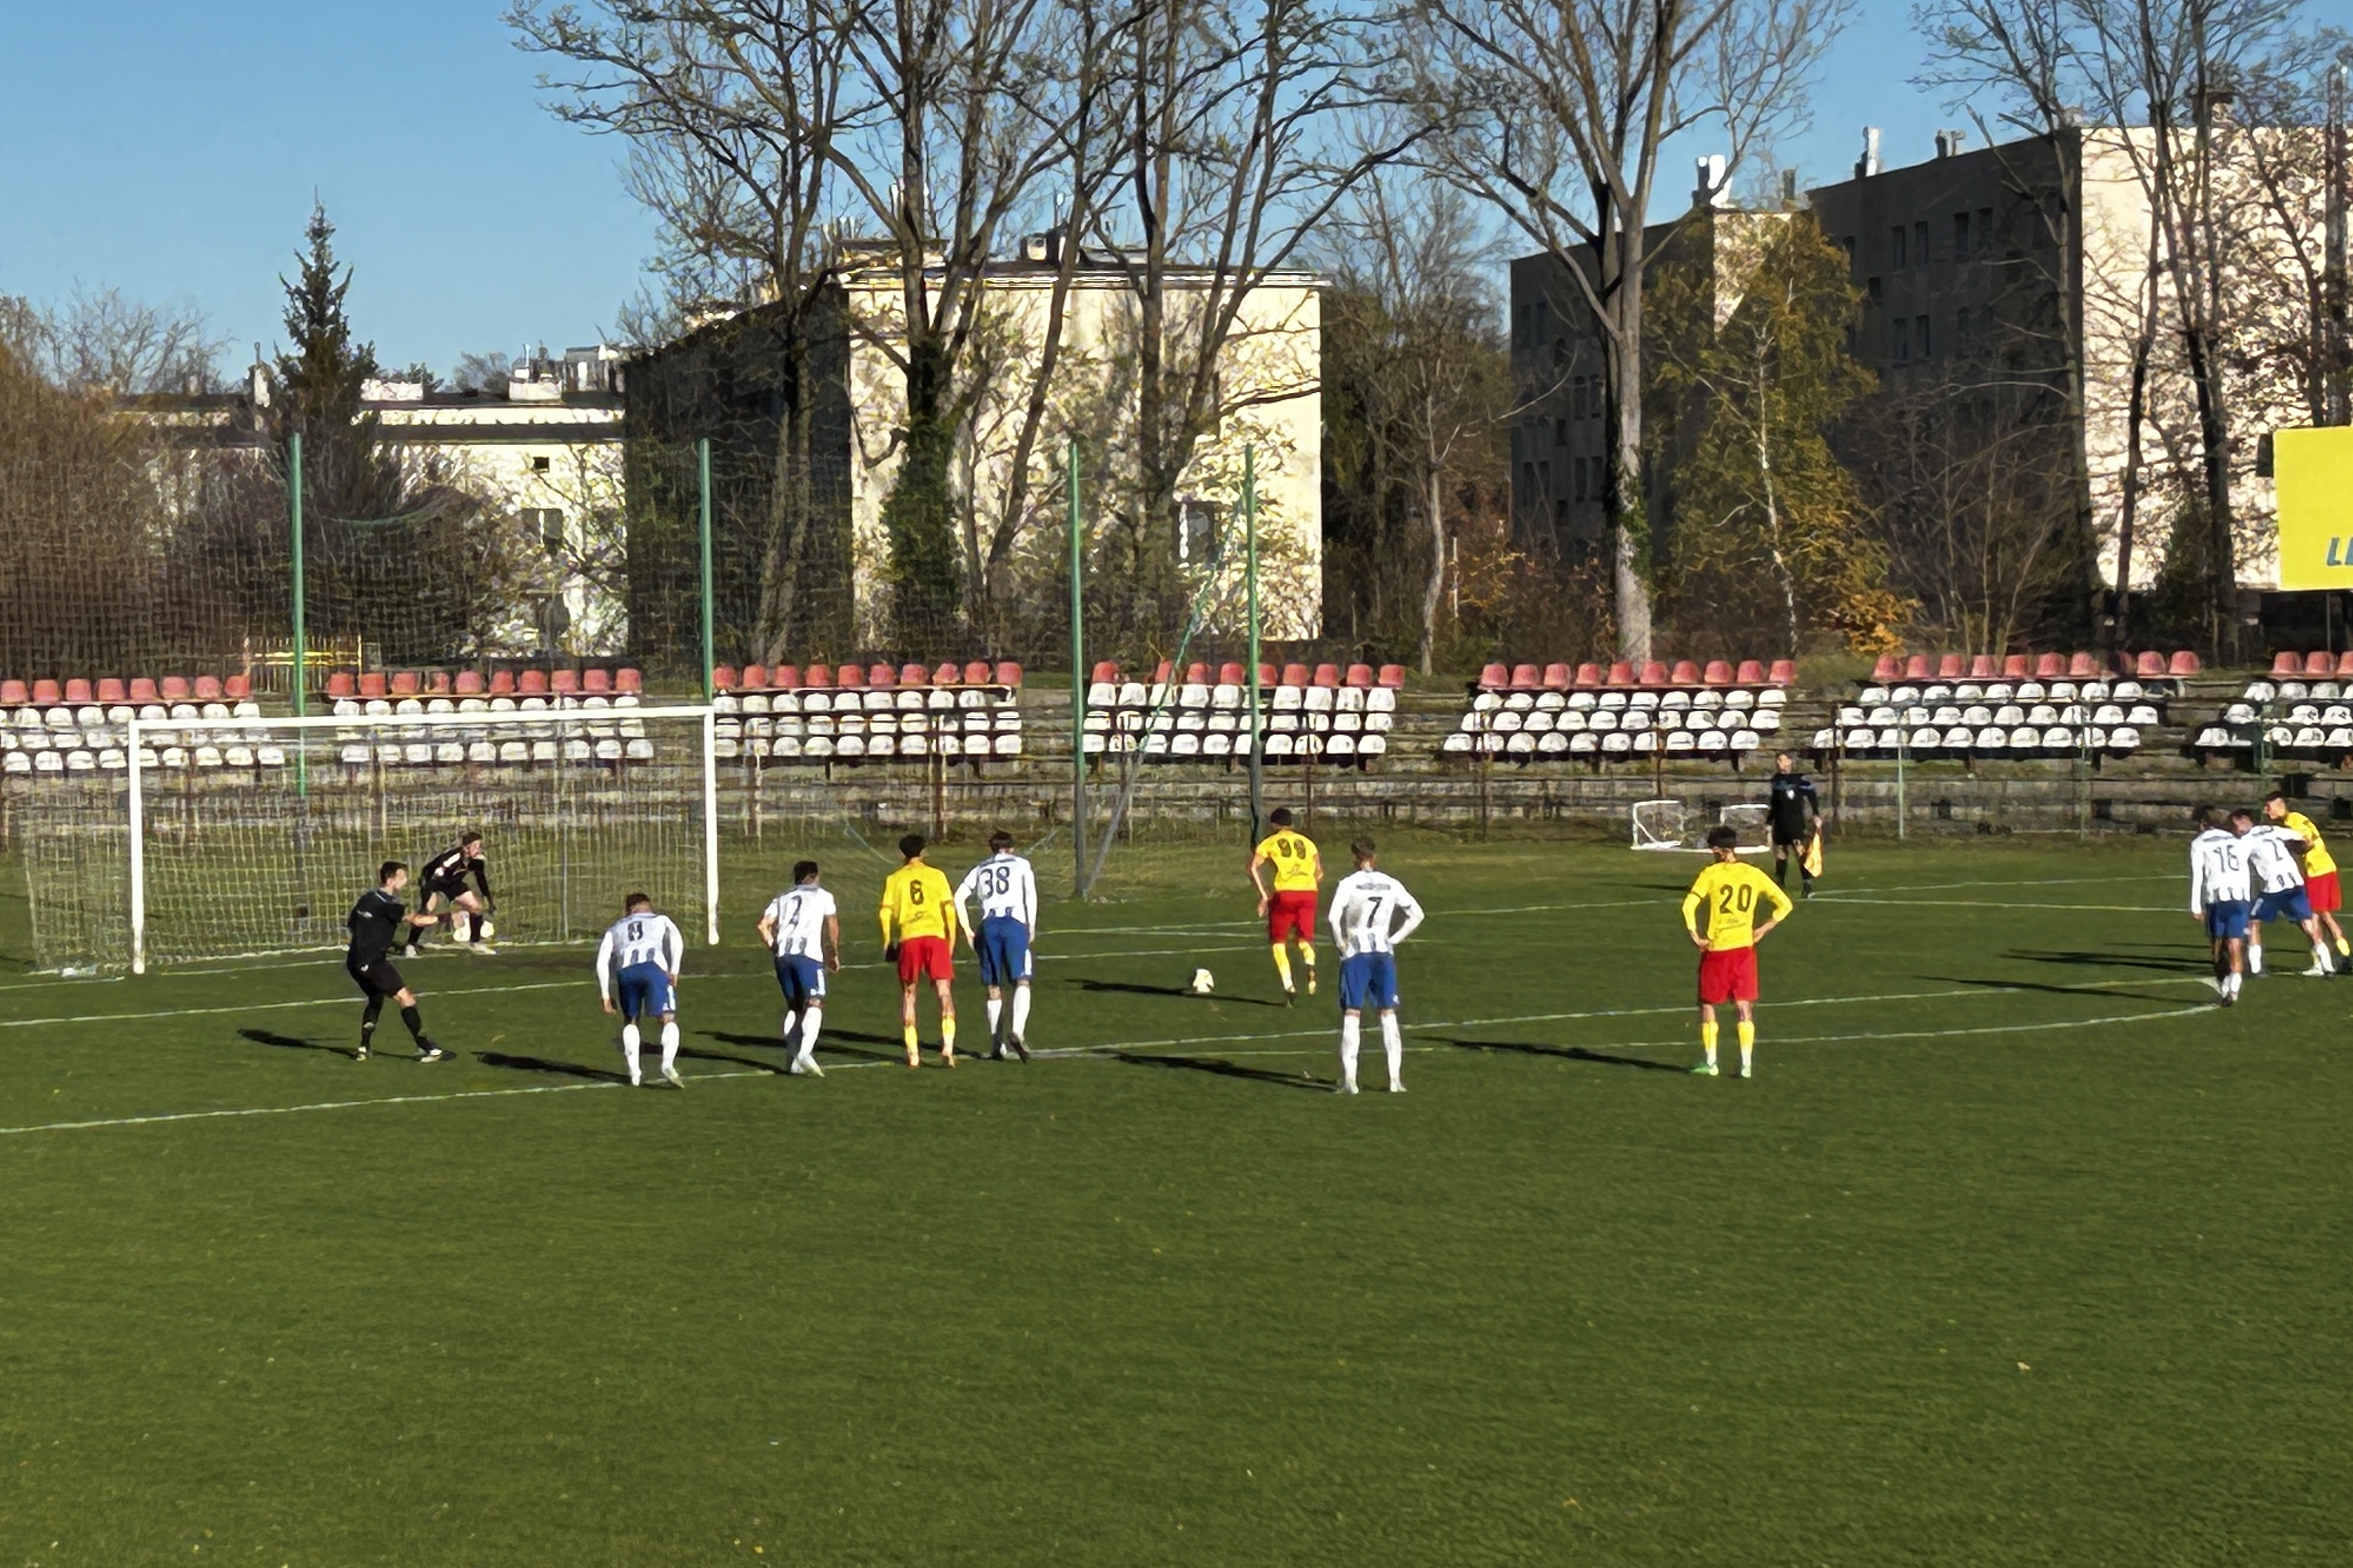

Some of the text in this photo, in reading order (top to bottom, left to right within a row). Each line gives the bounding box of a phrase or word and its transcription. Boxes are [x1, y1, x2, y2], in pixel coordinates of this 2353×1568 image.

[980, 866, 1010, 899] 38
[1719, 883, 1752, 914] 20
[1366, 896, 1383, 928] 7
